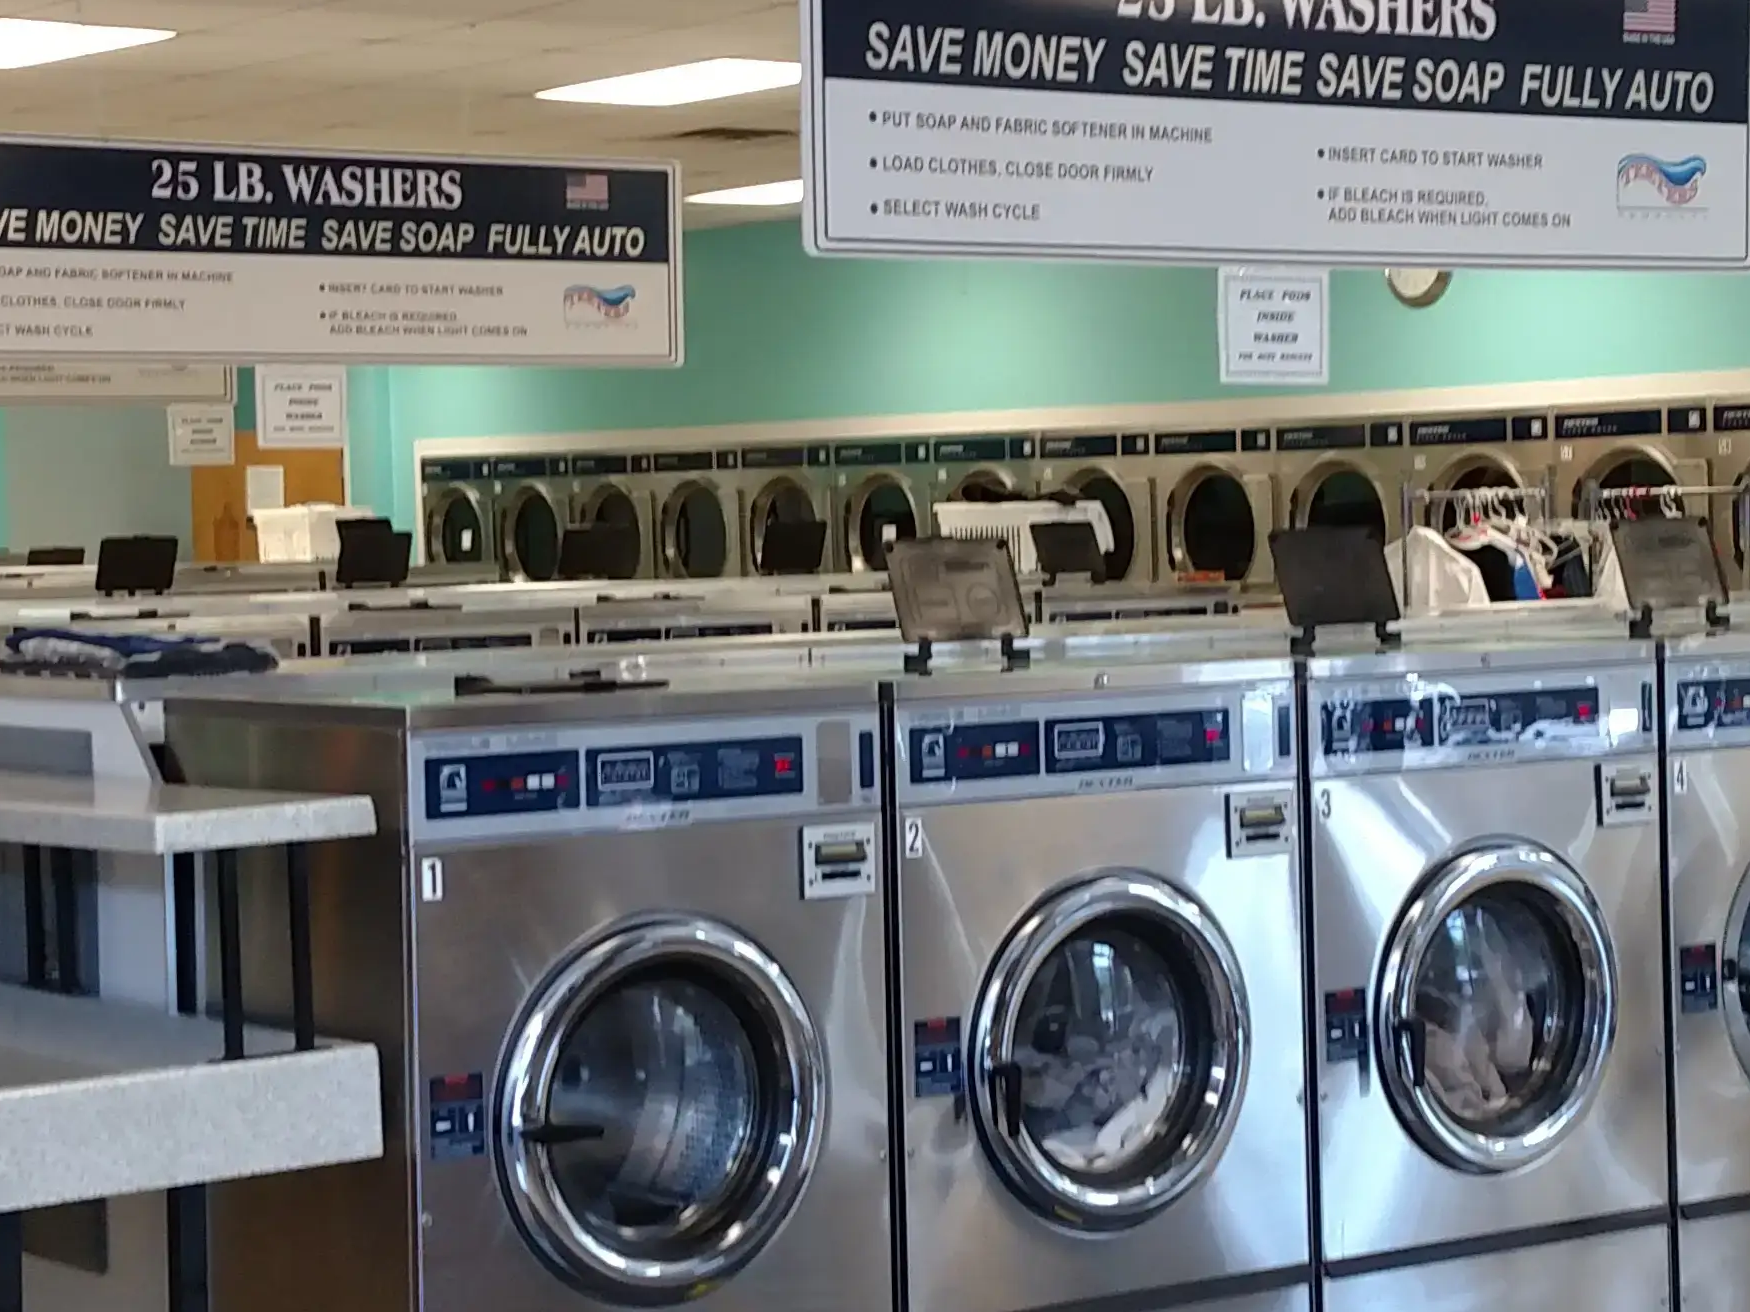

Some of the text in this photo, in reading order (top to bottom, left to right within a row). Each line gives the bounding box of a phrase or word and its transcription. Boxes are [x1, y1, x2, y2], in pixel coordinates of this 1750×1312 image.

[865, 21, 1714, 114] SAVE MONEY SAVE TIME SAVE SOAP FULLY AUTO
[882, 111, 1213, 143] PUT SOAP AND FABRIC SOFTENER IN MACHINE
[882, 155, 924, 174] LOAD
[1005, 161, 1054, 179] CLOSE
[1058, 163, 1100, 180] DOOR
[1103, 164, 1154, 183] FIRMLY
[1328, 147, 1544, 169] INSERT CARD TO START WASHER
[151, 158, 463, 210] 25 LB. WASHERS
[1328, 188, 1342, 202] IF
[1344, 189, 1399, 204] BLEACH
[1401, 190, 1414, 204] IS
[883, 199, 1041, 221] SELECT WASH CYCLE
[1328, 207, 1572, 229] ADD BLEACH WHEN LIGHT COMES ON
[35, 208, 145, 245] MONEY
[157, 213, 234, 248] SAVE
[241, 214, 308, 250] TIME
[321, 218, 394, 252] SAVE
[399, 220, 475, 254] SOAP
[487, 223, 572, 256] FULLY
[572, 226, 646, 258] AUTO
[26, 267, 52, 279] AND
[55, 267, 98, 280] FABRIC
[101, 269, 164, 281] SOFTENER
[181, 270, 234, 283] MACHINE
[370, 283, 402, 295] CARD
[458, 285, 504, 296] WASHER
[63, 296, 104, 309] CLOSE
[107, 297, 141, 309] DOOR
[144, 298, 186, 311] FIRMLY
[15, 325, 50, 337] WASH
[53, 325, 94, 337] CYCLE
[1321, 789, 1331, 818] 3
[908, 821, 919, 853] 2
